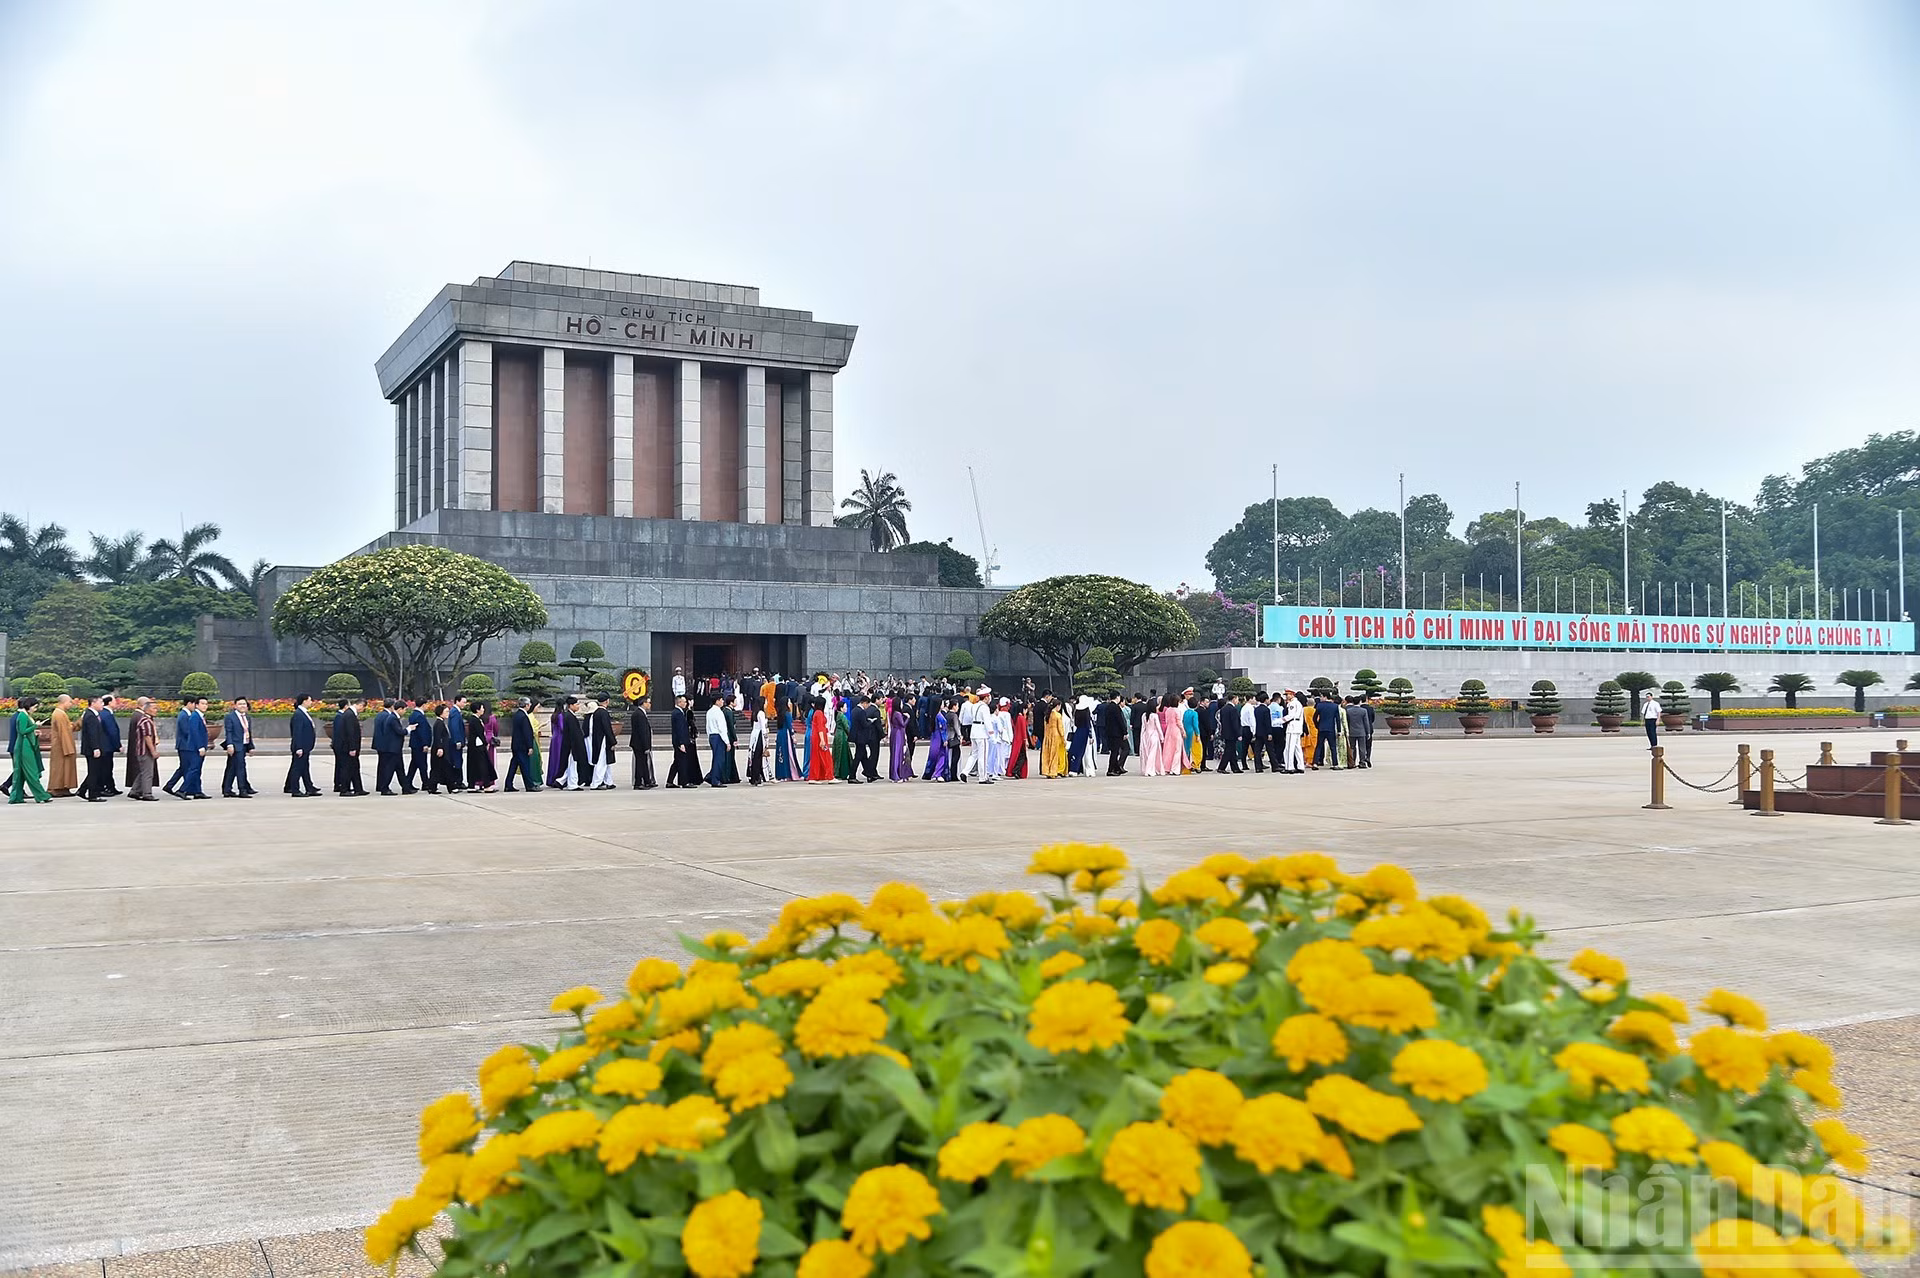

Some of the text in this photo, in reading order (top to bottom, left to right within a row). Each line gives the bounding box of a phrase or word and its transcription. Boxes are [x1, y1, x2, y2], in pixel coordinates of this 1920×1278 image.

[1298, 608, 1336, 638] CHỦ
[1344, 615, 1385, 642] TỊCH
[1393, 609, 1416, 640] HỒ
[1423, 613, 1453, 640] CHÍ
[1460, 618, 1504, 641] MINH
[1511, 615, 1528, 641] VĨ
[1534, 620, 1561, 646] ĐẠI
[1568, 615, 1611, 643] SỐNG
[1617, 619, 1646, 644] MÃI
[1652, 623, 1701, 644] TRONG
[1706, 622, 1726, 648] SỰ
[1730, 621, 1781, 648] NGHIỆP
[1786, 620, 1813, 646] CỦA
[1818, 626, 1861, 647] CHÚNG
[1867, 628, 1882, 647] TA
